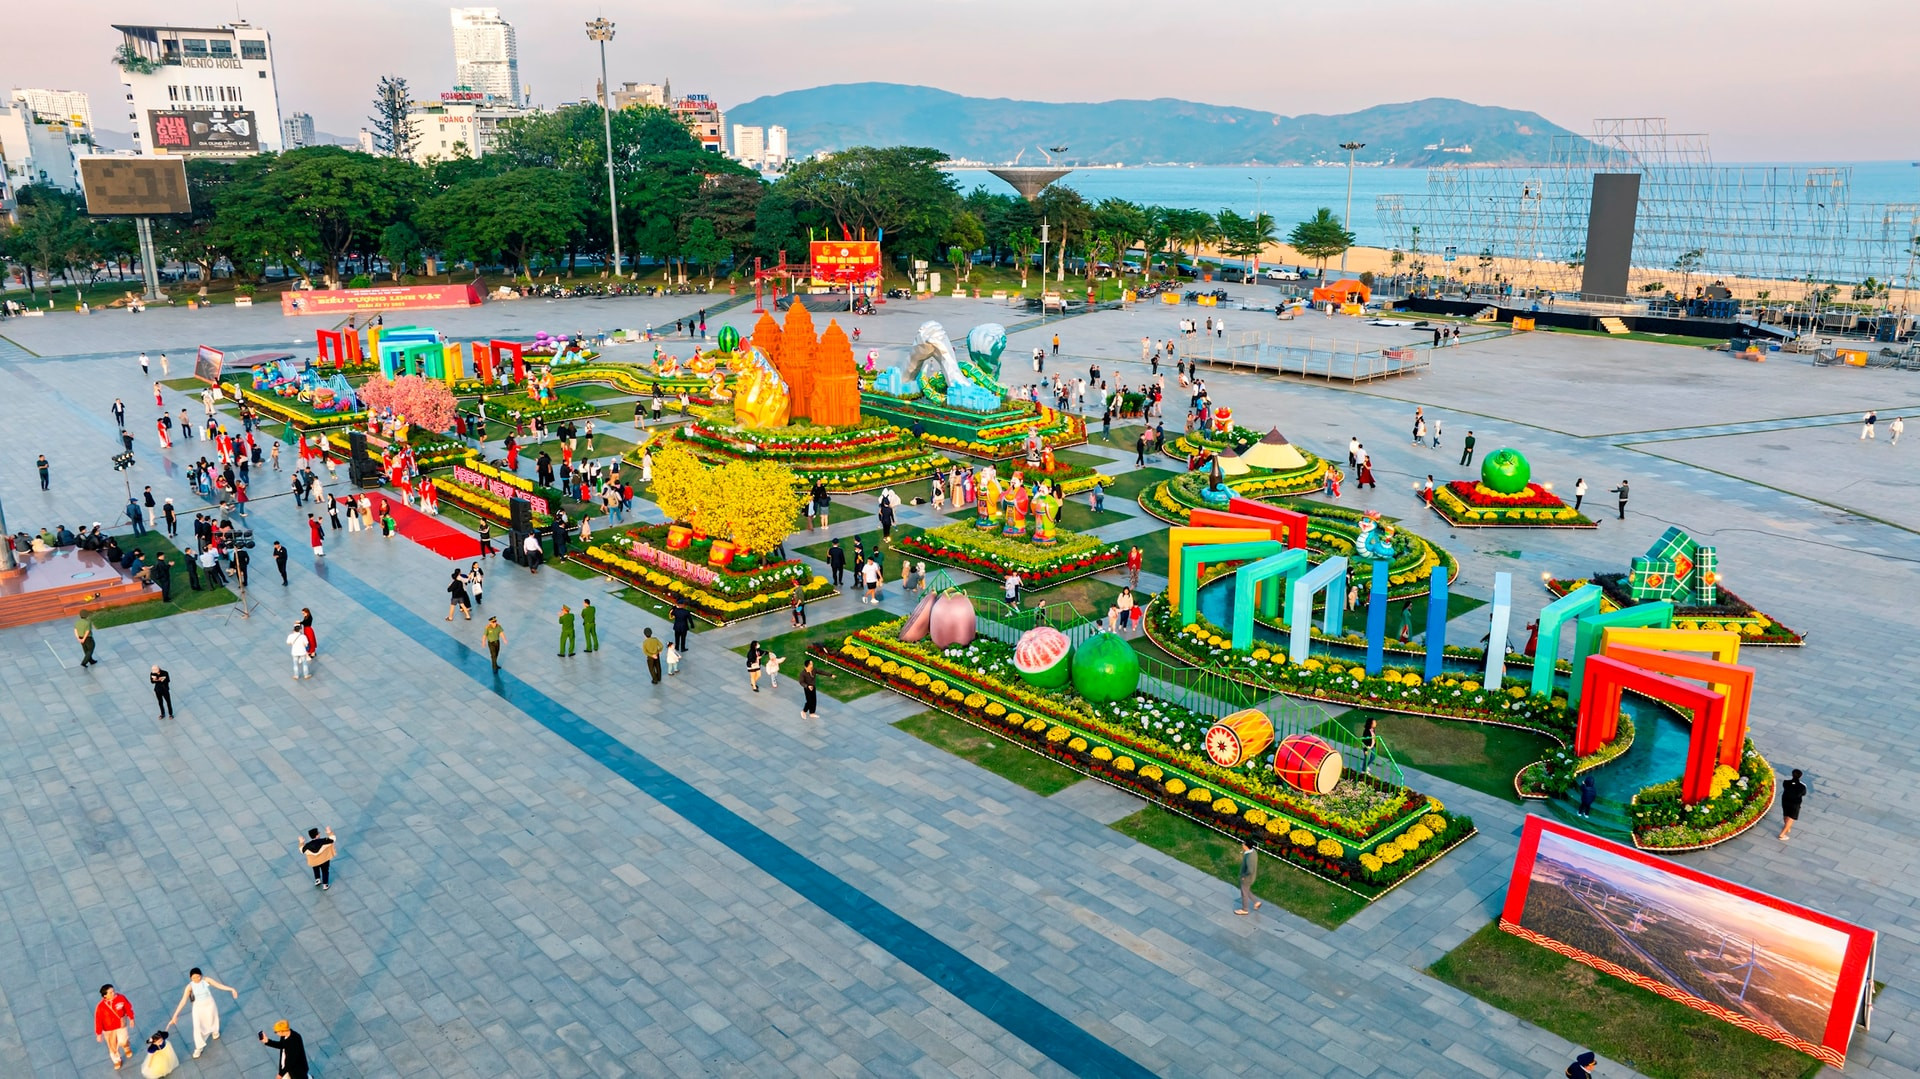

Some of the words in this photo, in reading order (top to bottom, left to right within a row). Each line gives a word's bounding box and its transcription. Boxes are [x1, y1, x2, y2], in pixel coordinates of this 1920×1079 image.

[182, 57, 214, 69] MENTO
[216, 59, 243, 69] HOTEL
[157, 116, 185, 127] JUN
[438, 115, 464, 123] HOÀNG
[156, 126, 189, 136] GER
[453, 465, 487, 490] HAPPY
[489, 478, 515, 500] NEW
[515, 489, 548, 515] YEAR
